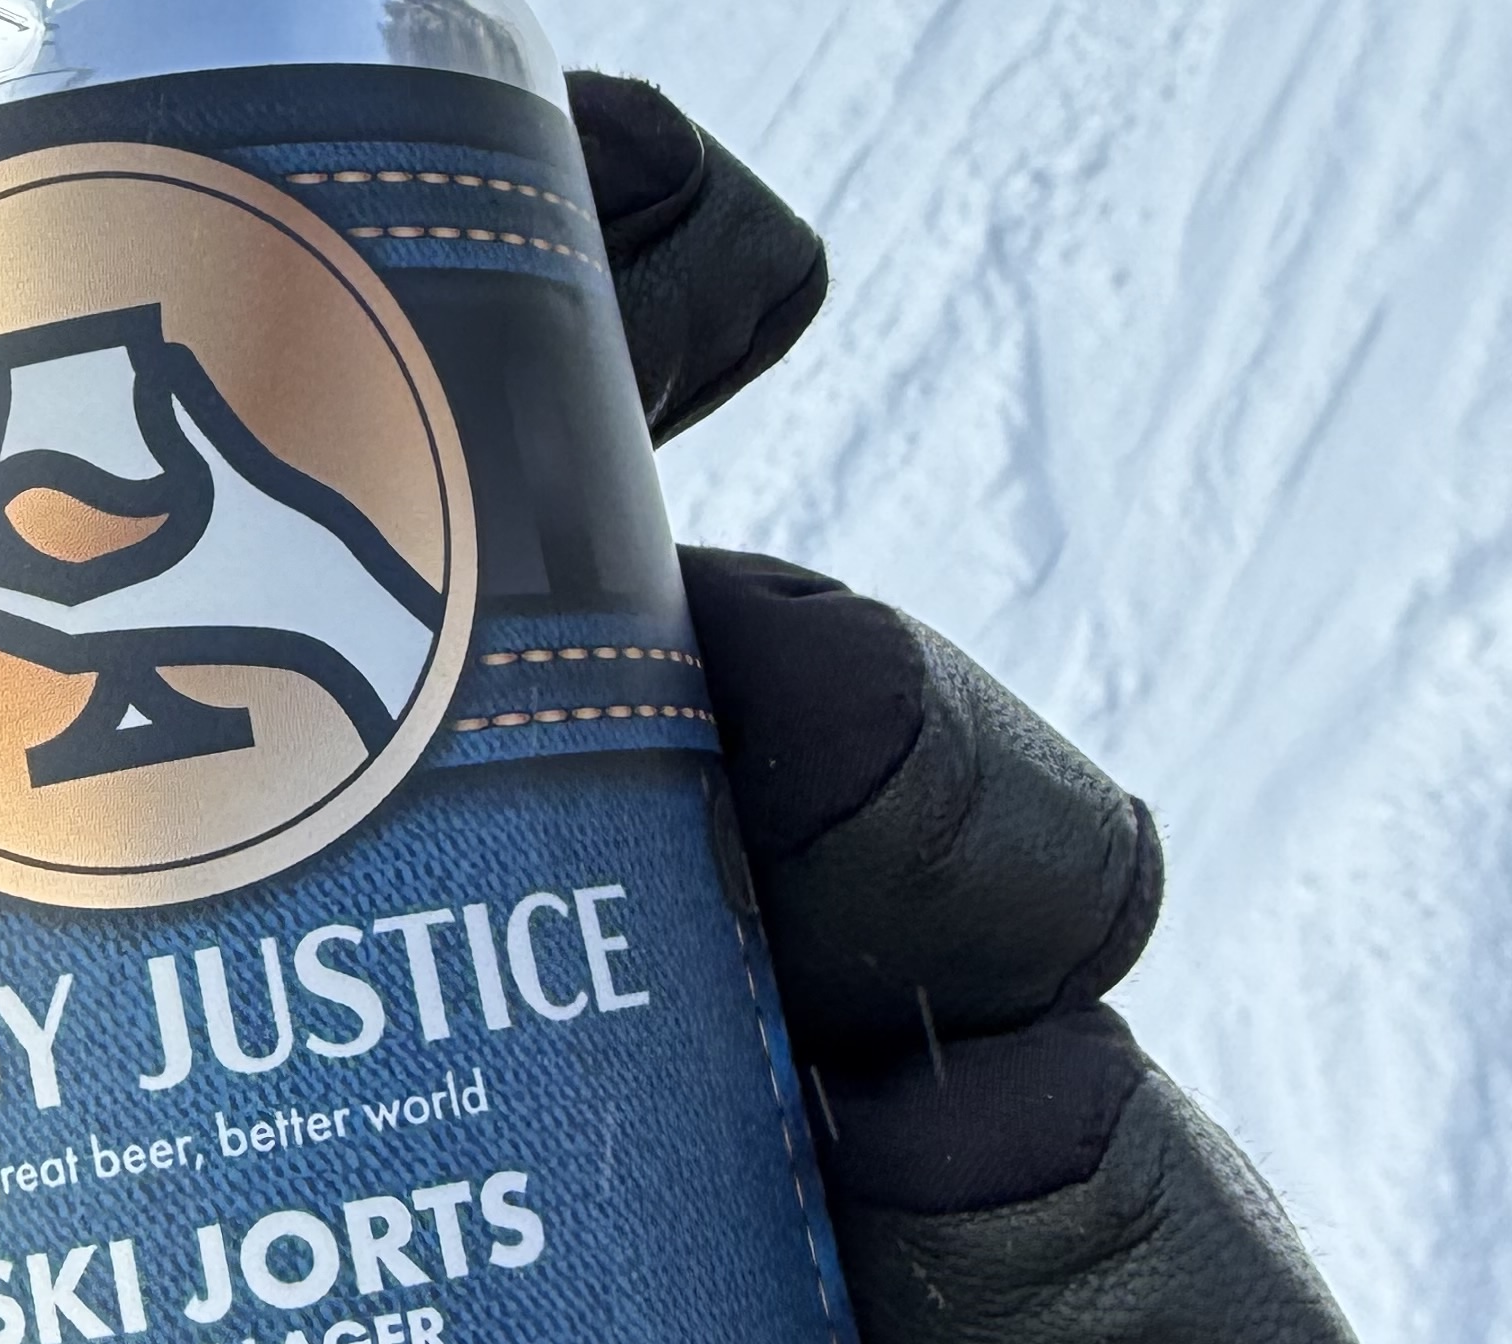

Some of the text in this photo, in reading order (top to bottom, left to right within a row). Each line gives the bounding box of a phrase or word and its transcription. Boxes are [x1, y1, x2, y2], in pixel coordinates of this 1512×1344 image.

[138, 884, 650, 1093] JUSTICE
[89, 1132, 205, 1180] beer,
[214, 1107, 350, 1157] better
[361, 1067, 489, 1132] world
[183, 1170, 545, 1325] JORTS
